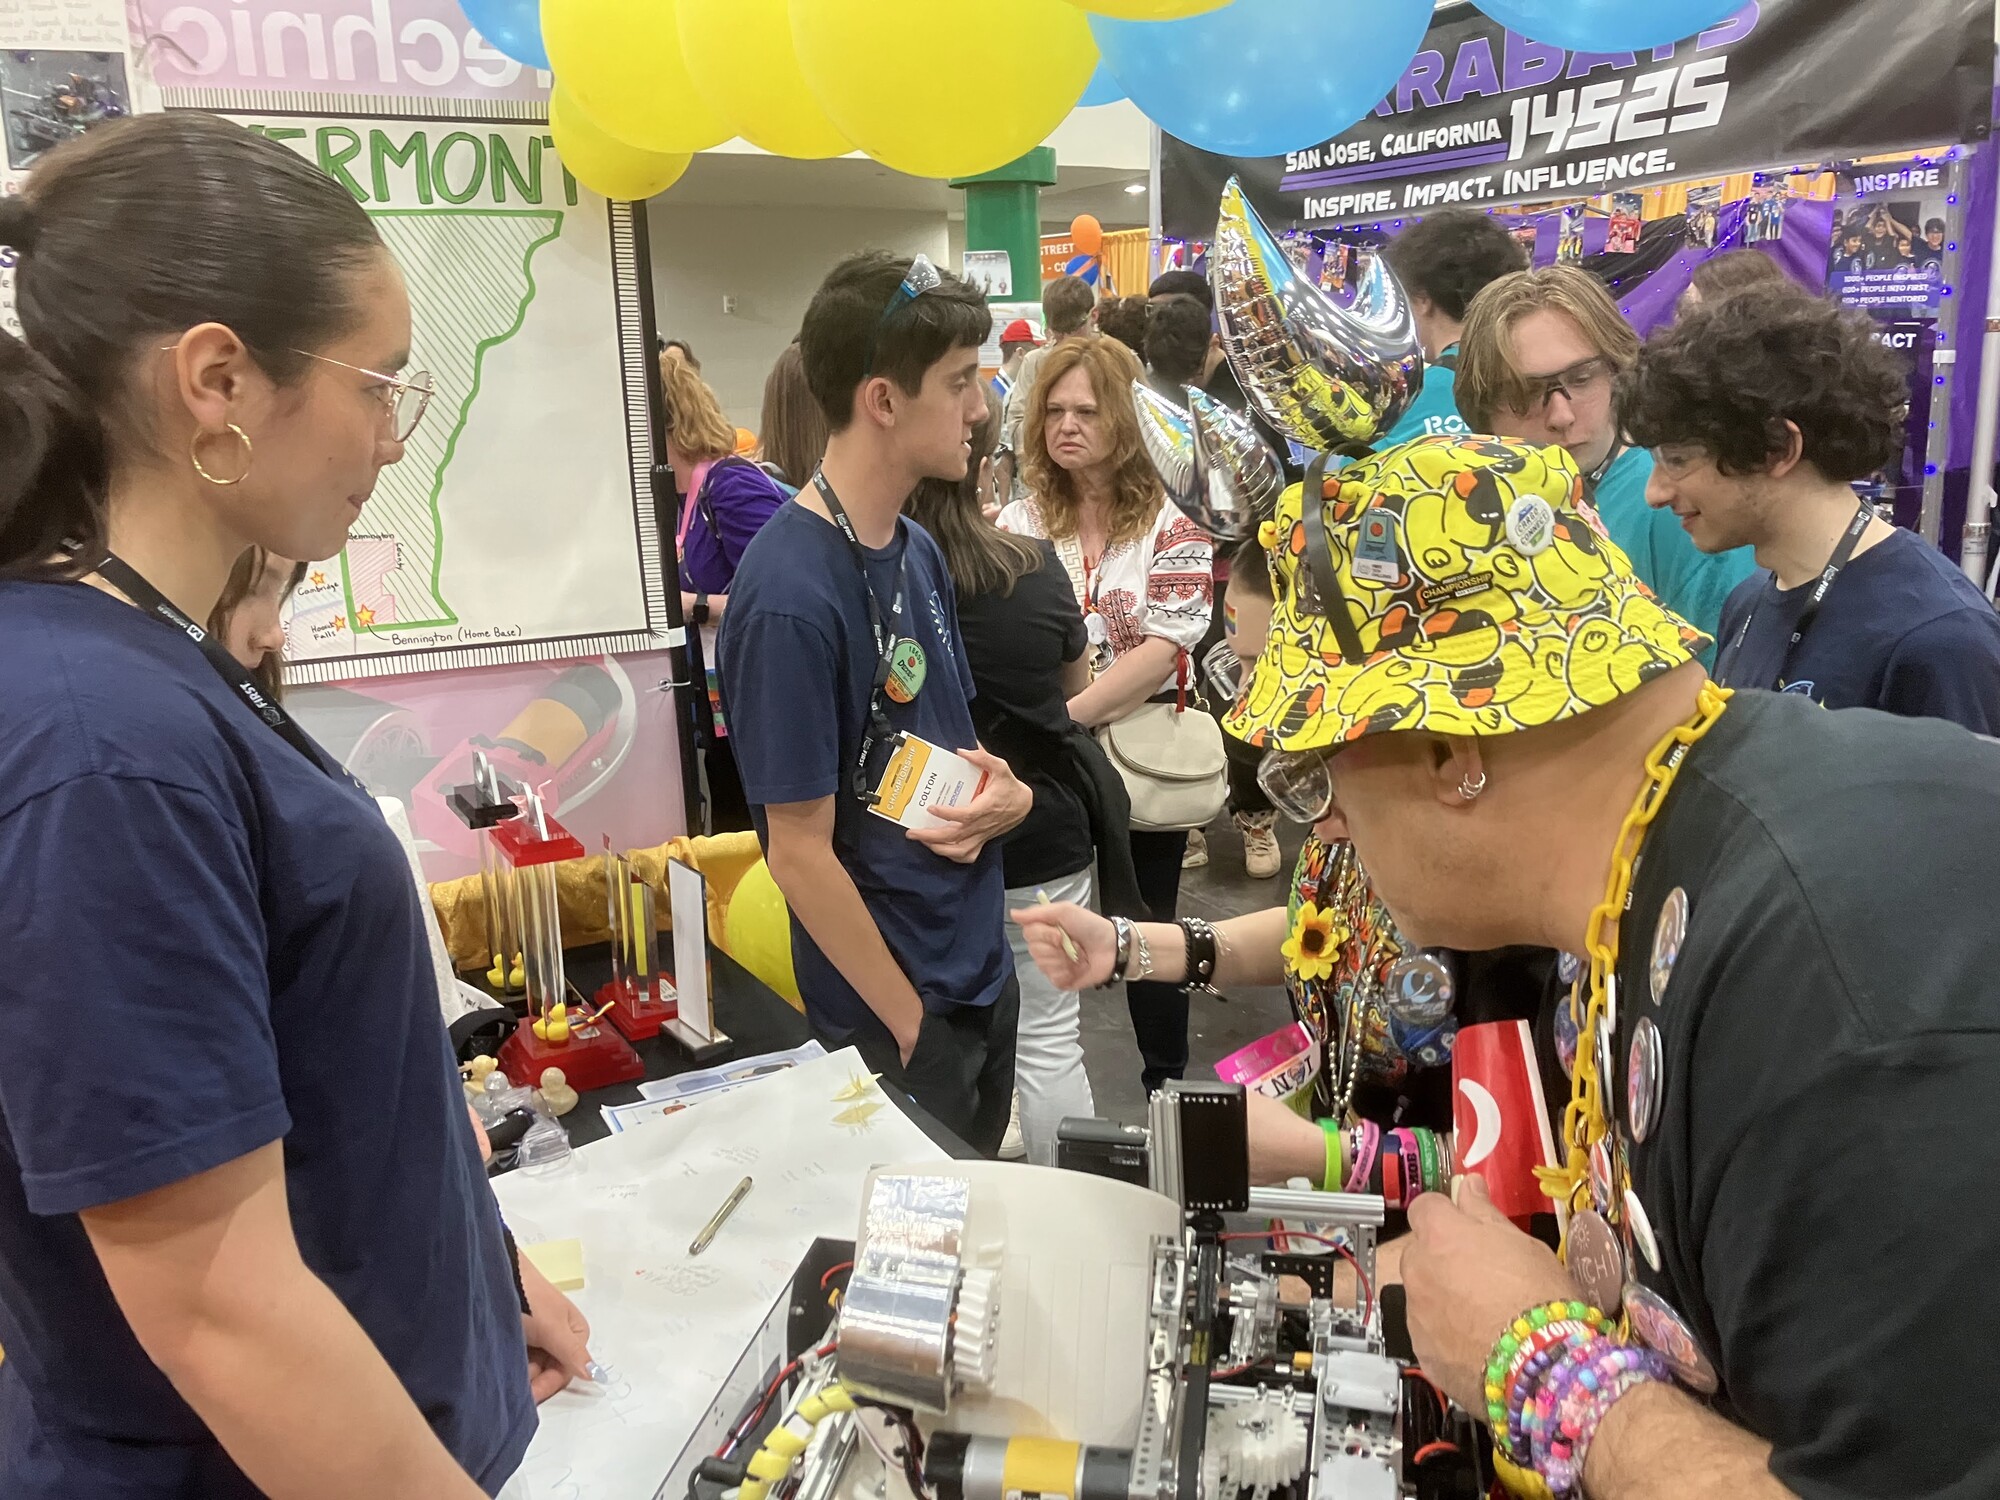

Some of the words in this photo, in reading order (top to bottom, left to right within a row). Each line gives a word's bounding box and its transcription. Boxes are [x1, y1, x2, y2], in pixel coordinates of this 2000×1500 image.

[1507, 55, 1729, 161] 14525
[1285, 149, 1321, 172] SAN
[1323, 140, 1376, 167] JOSE,
[1380, 118, 1502, 156] CALIFORNIA
[247, 125, 578, 206] RMON
[1303, 190, 1397, 219] INSPIRE.
[1403, 176, 1495, 208] IMPACT.
[1502, 148, 1676, 195] INFLUENCE.
[1854, 169, 1939, 192] INSPIRE
[1887, 284, 1906, 292] INTO
[1892, 272, 1928, 281] INSPIRED
[1886, 295, 1928, 303] MENTORED
[297, 582, 339, 596] Cambridge
[1422, 573, 1492, 599] CHAMPIONSHIP
[313, 630, 336, 641] Falls
[391, 631, 453, 646] Bennington
[457, 626, 491, 642] (Home
[493, 624, 522, 637] Base)
[239, 680, 269, 709] FIRST
[1668, 743, 1691, 768] FIRS
[886, 745, 918, 811] CHAMPIONSHIP
[918, 772, 938, 807] COLTON
